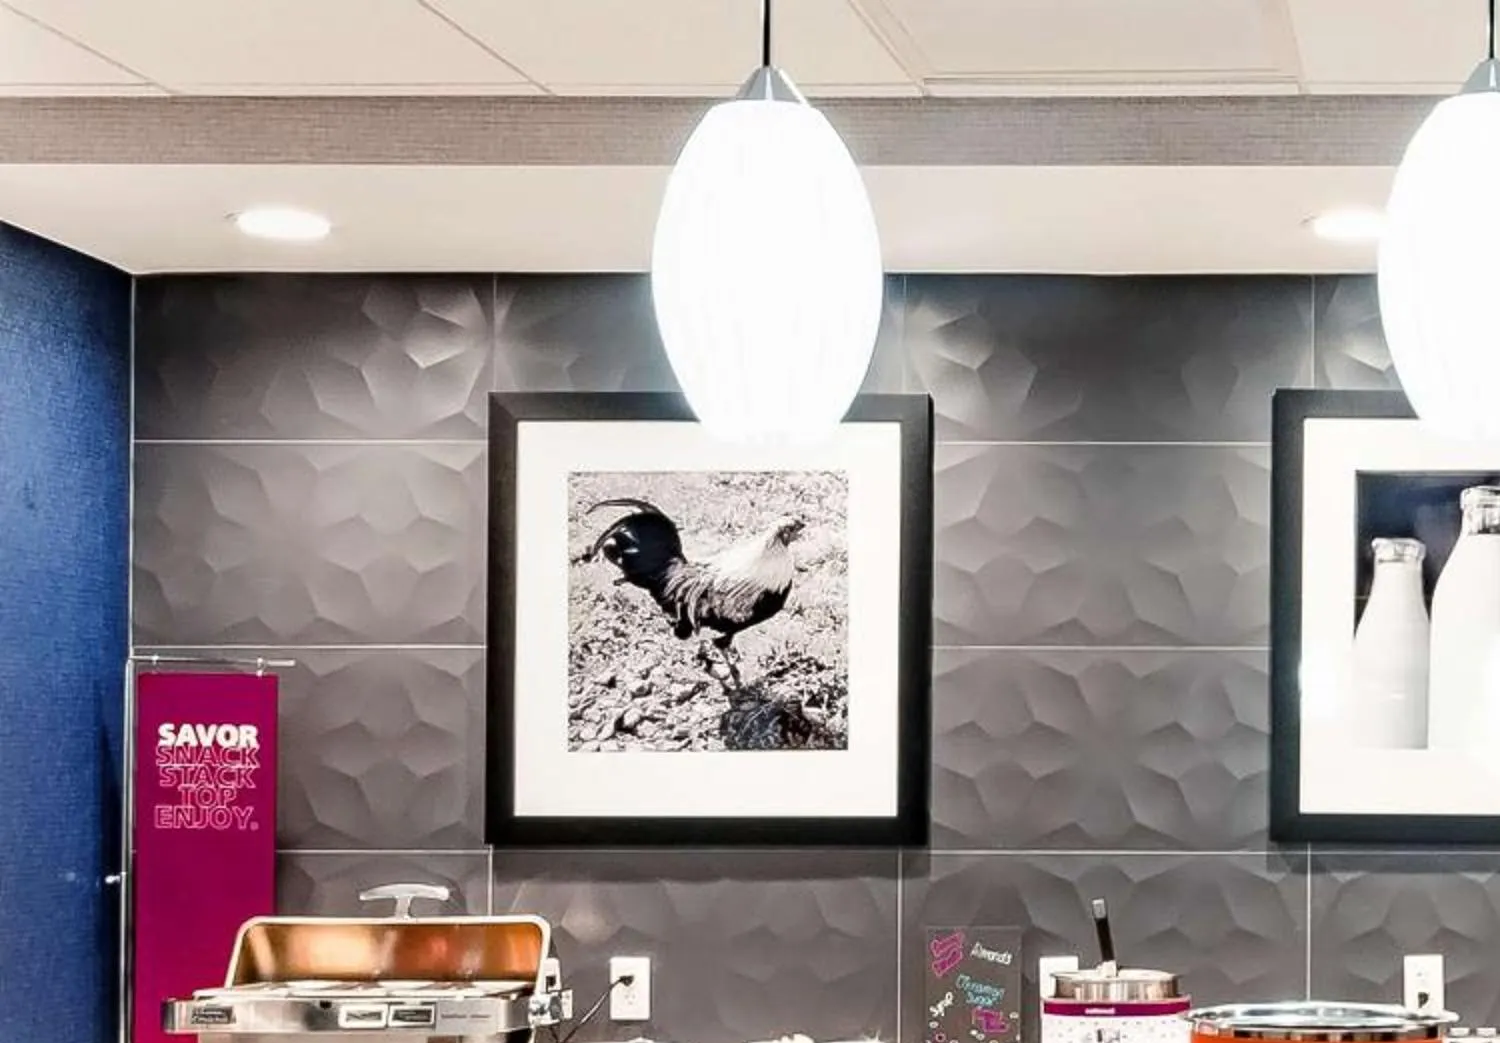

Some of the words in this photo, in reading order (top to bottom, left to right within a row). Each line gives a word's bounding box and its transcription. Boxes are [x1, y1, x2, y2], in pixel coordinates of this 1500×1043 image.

[158, 723, 259, 748] SAVOR
[156, 746, 260, 768] SNACK
[159, 766, 256, 788] STACK
[178, 784, 236, 808] TOP
[155, 805, 259, 830] ENJOY.
